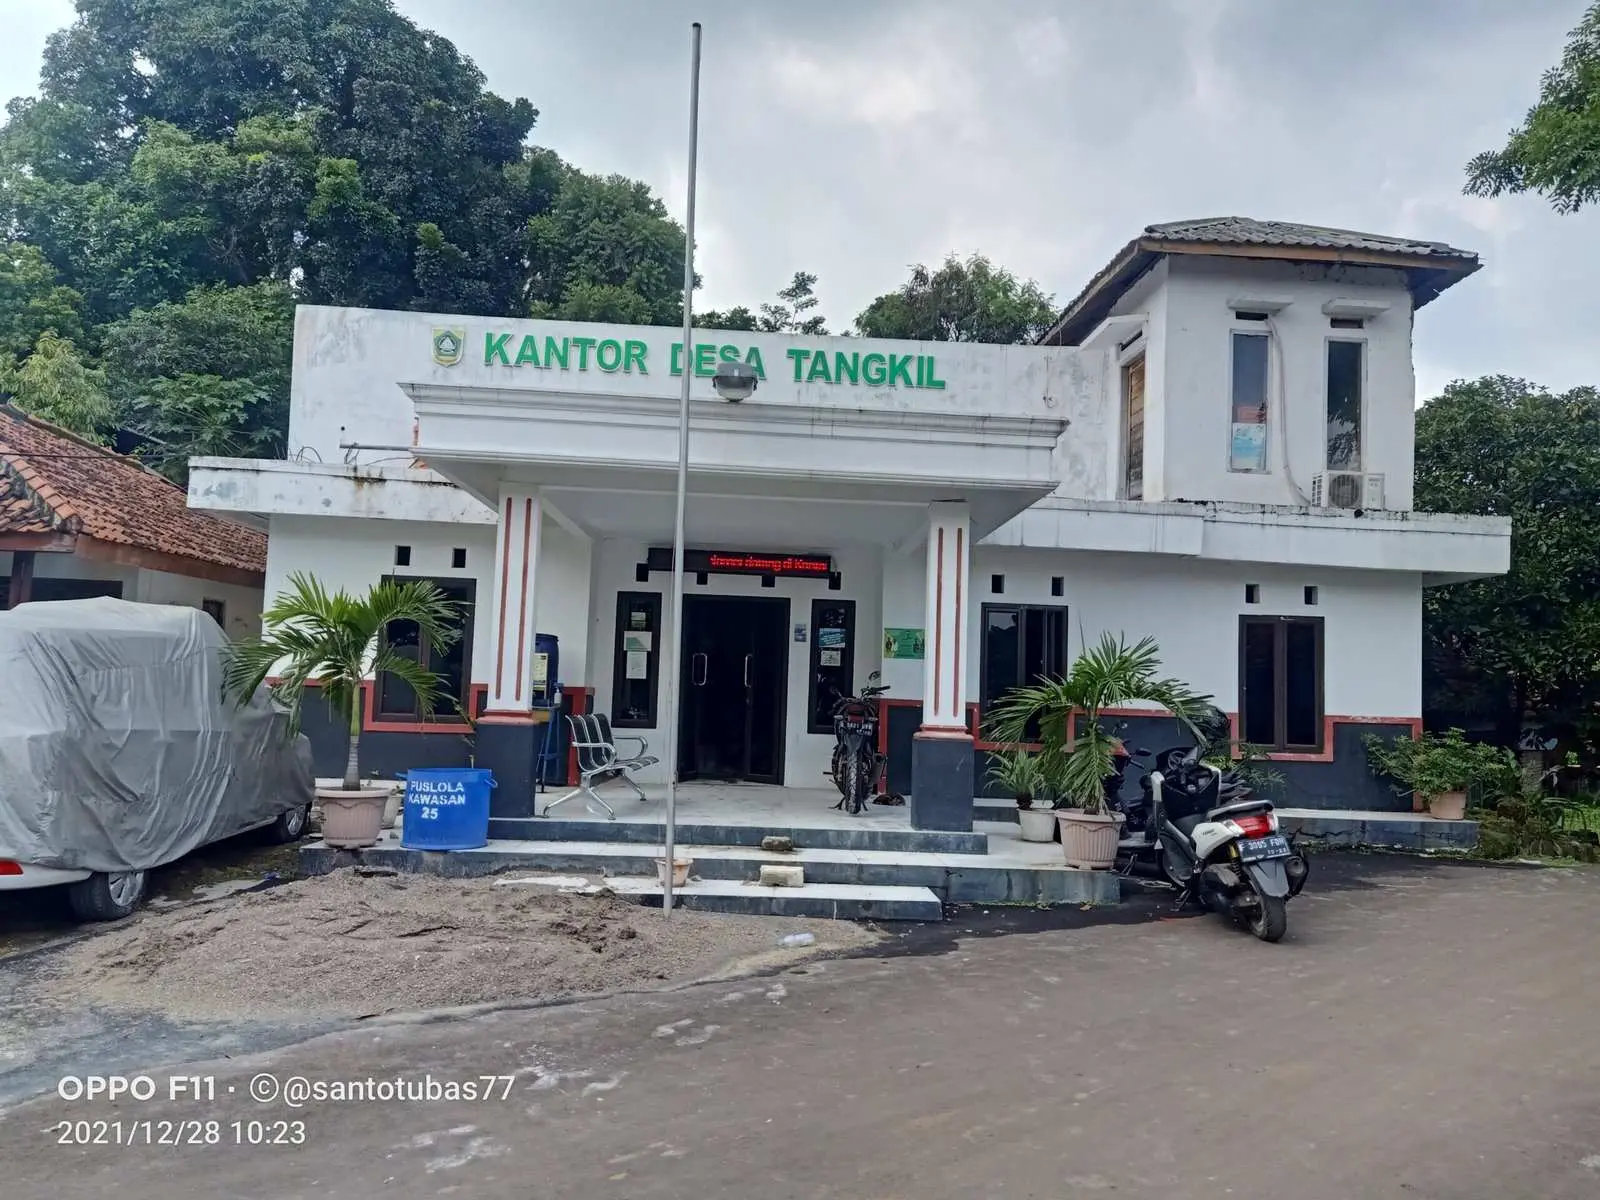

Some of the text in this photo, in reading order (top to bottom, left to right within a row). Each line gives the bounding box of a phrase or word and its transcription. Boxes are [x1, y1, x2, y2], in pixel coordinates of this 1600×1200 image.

[484, 331, 648, 374] KANTOR
[786, 348, 947, 389] TANGKIL
[408, 793, 465, 804] KAWASAN
[421, 807, 438, 819] 25
